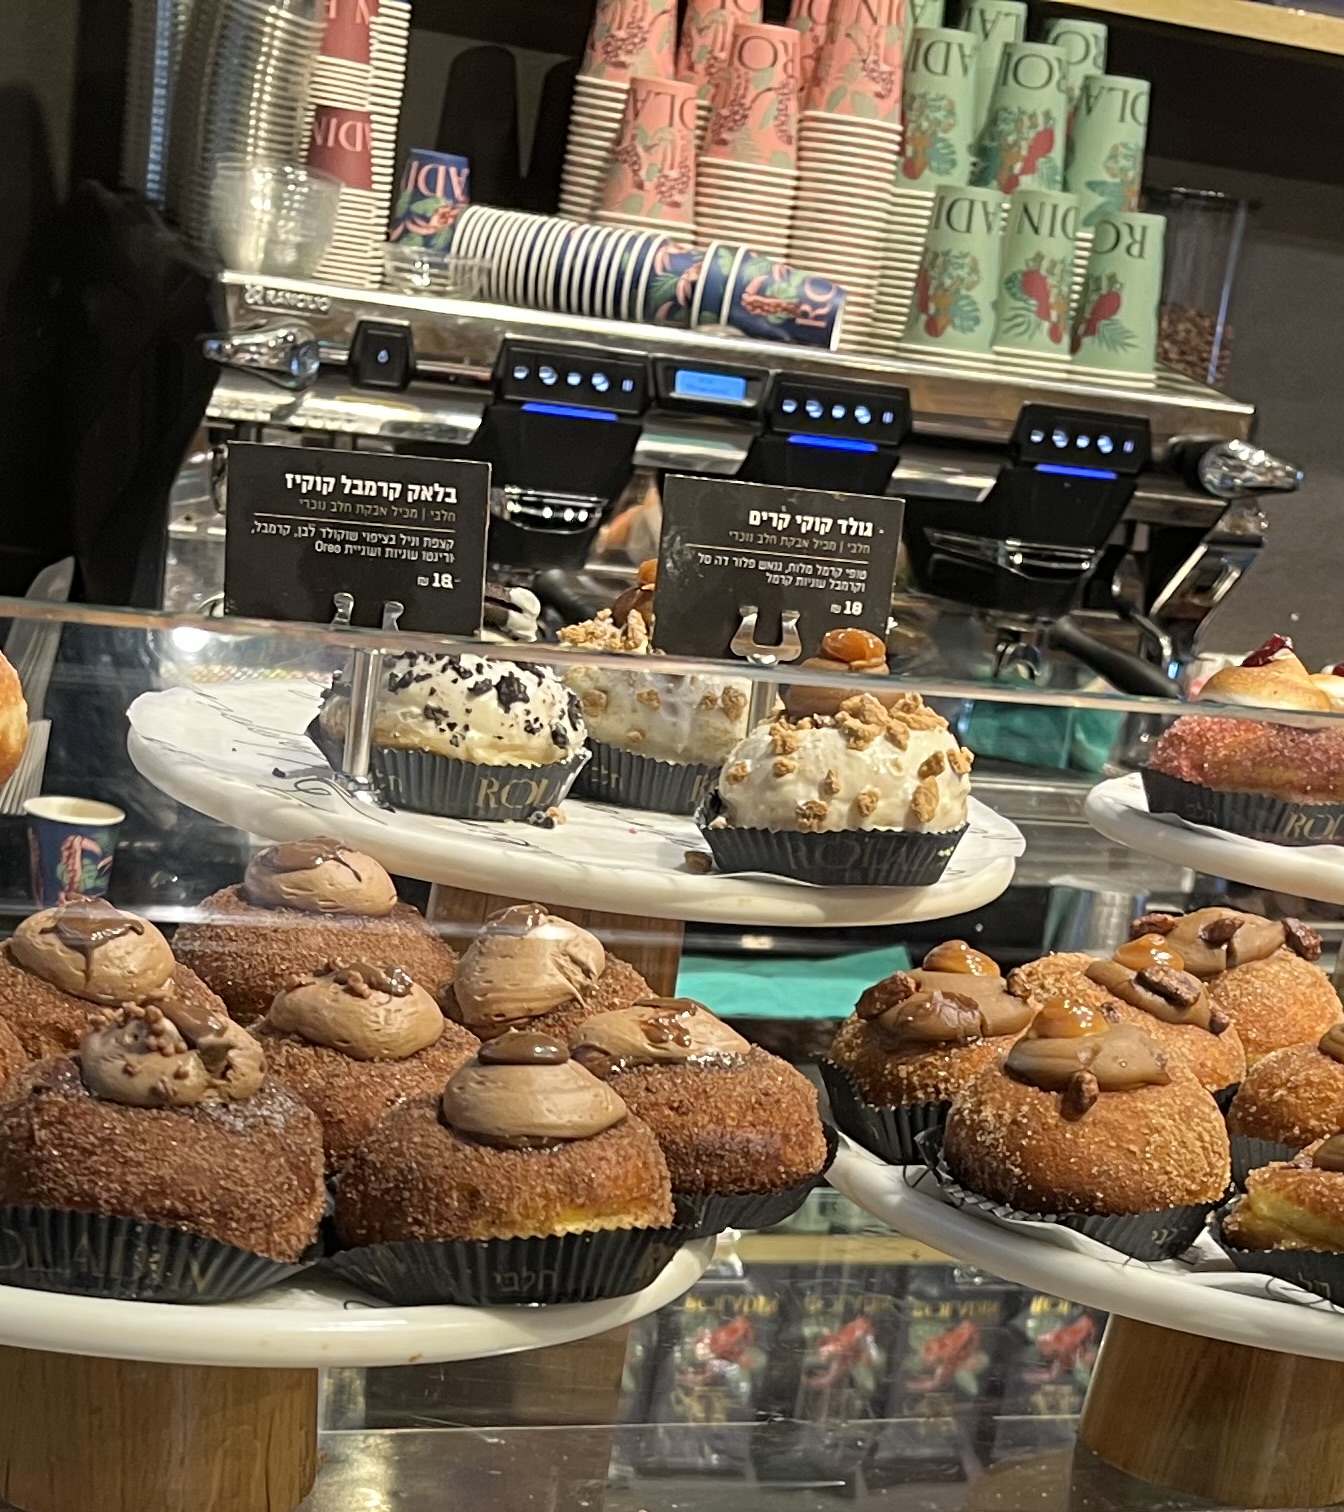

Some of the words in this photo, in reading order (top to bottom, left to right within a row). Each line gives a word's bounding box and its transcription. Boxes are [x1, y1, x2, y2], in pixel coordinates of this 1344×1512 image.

[286, 474, 335, 495] קוקיז
[341, 475, 402, 501] קרמבל
[408, 483, 457, 503] בלאק
[749, 511, 791, 530] קרים
[796, 515, 833, 535] קוקי
[837, 519, 873, 537] גולד
[315, 541, 341, 553] Oreo
[432, 572, 454, 589] 18
[844, 601, 863, 615] 18
